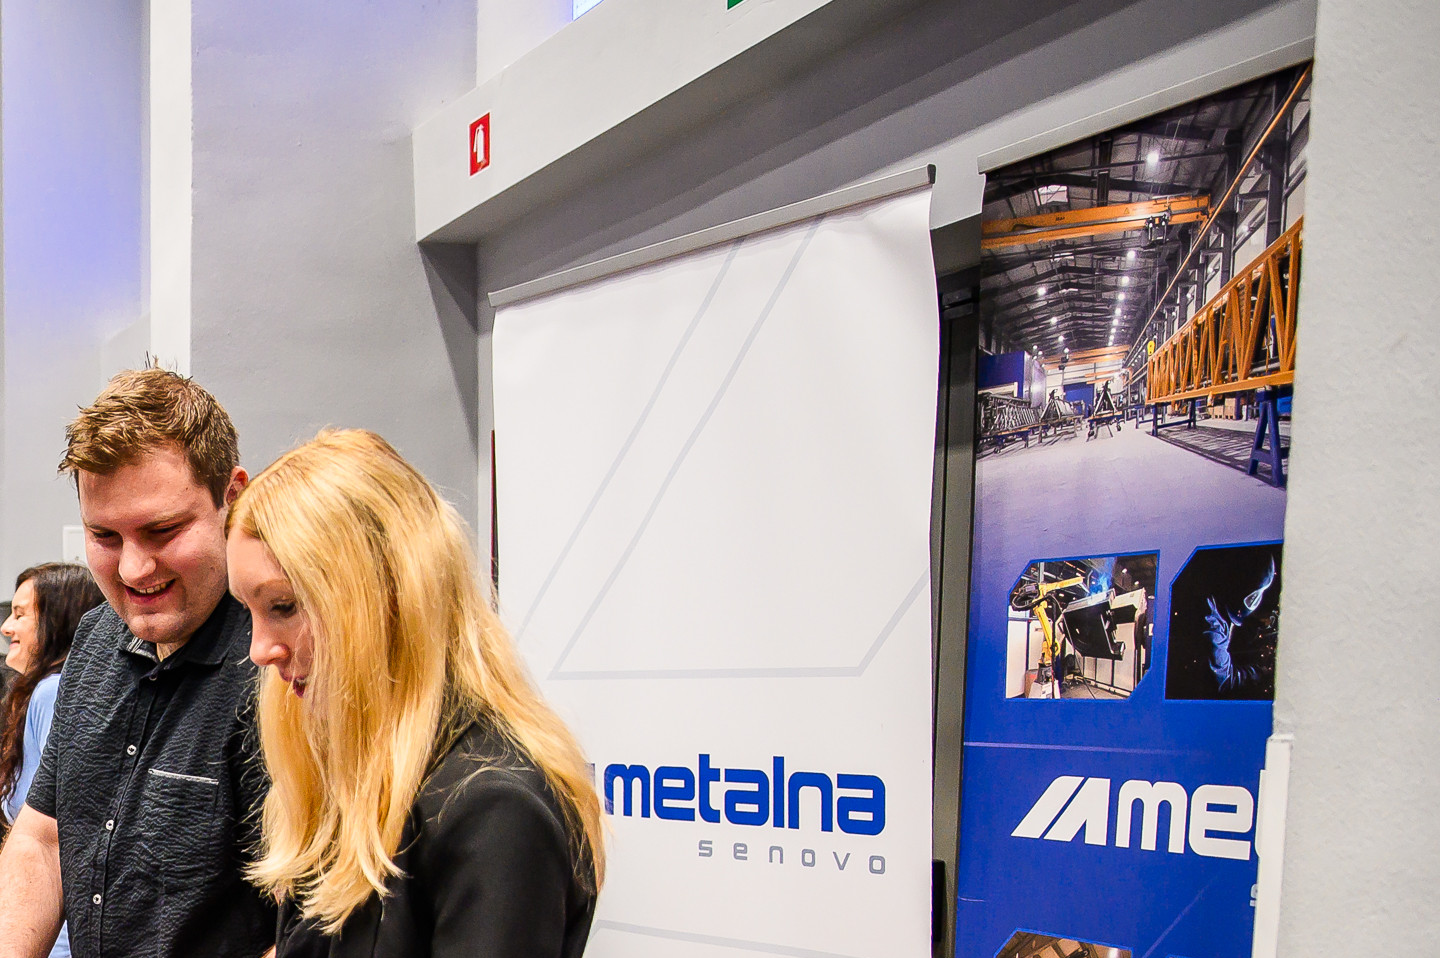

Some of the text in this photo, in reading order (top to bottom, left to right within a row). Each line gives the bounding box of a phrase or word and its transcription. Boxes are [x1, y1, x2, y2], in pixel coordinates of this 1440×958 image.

[604, 754, 886, 836] metalna
[1115, 771, 1261, 861] me
[698, 839, 886, 875] senovo
